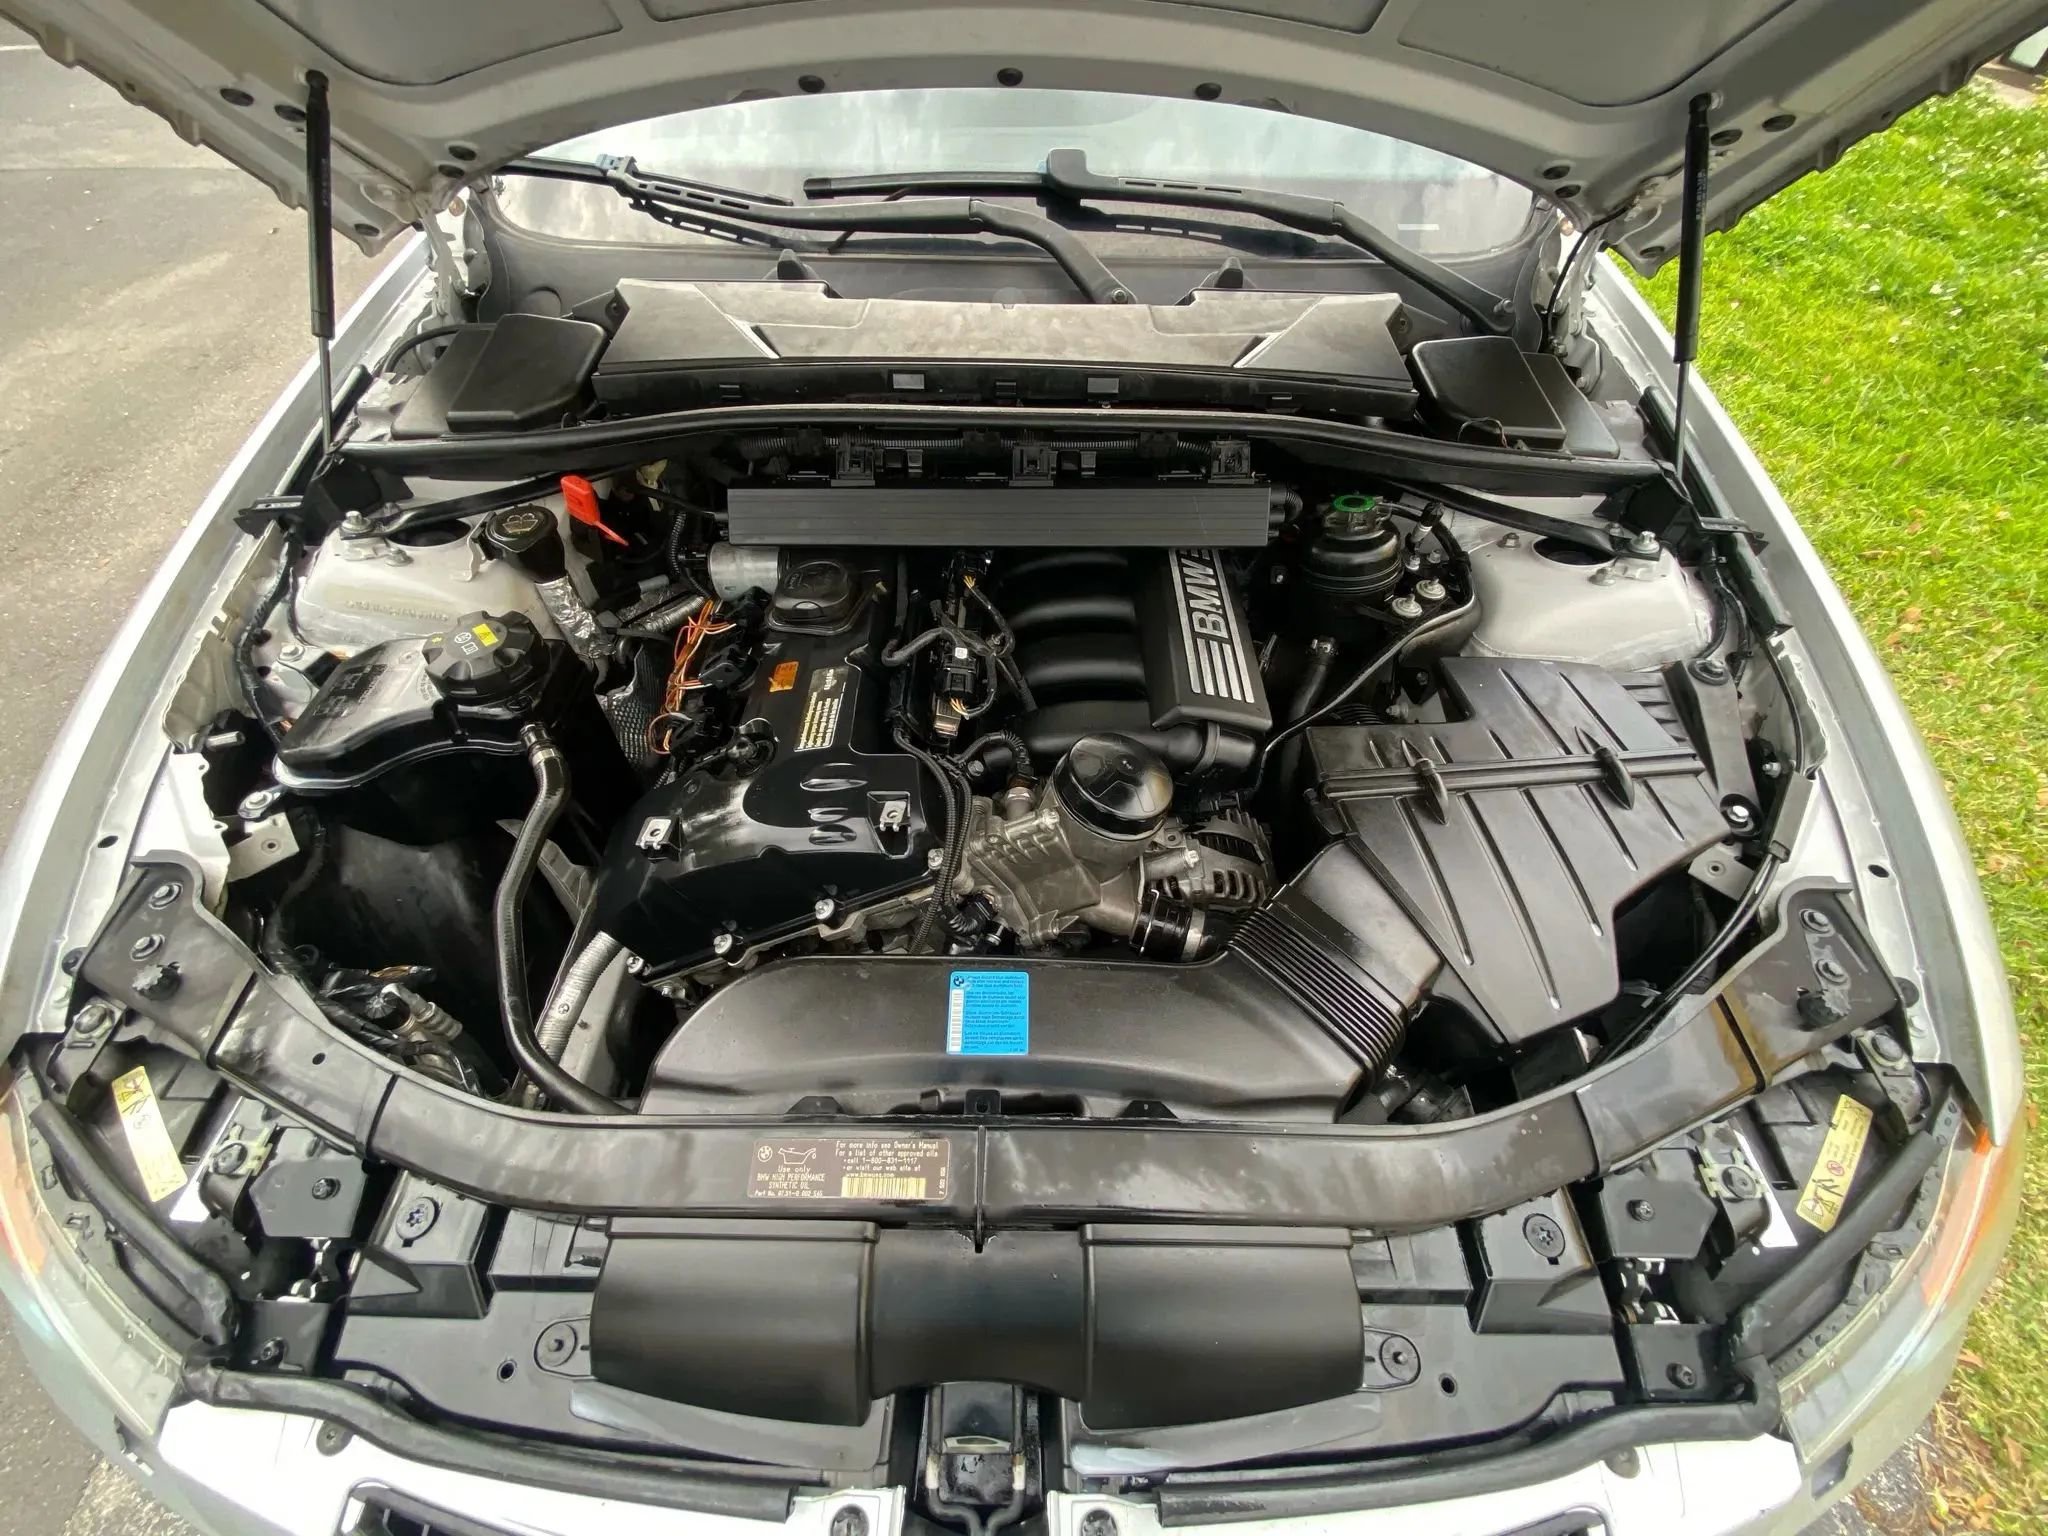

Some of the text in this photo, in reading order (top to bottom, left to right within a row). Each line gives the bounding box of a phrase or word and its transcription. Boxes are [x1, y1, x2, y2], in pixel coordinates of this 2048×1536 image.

[1181, 558, 1228, 639] BMW
[836, 1141, 846, 1149] For
[866, 1141, 878, 1149] info
[894, 1141, 915, 1149] Owner's
[918, 1141, 938, 1149] Manual
[835, 1149, 845, 1157] For
[855, 1149, 866, 1157] list
[869, 1149, 875, 1157] of
[878, 1149, 894, 1157] other
[897, 1150, 923, 1158] approved
[795, 1164, 811, 1174] only
[757, 1173, 770, 1181] BMW
[787, 1173, 825, 1181] PERFORMANCE
[769, 1181, 798, 1190] SYNTHETIC
